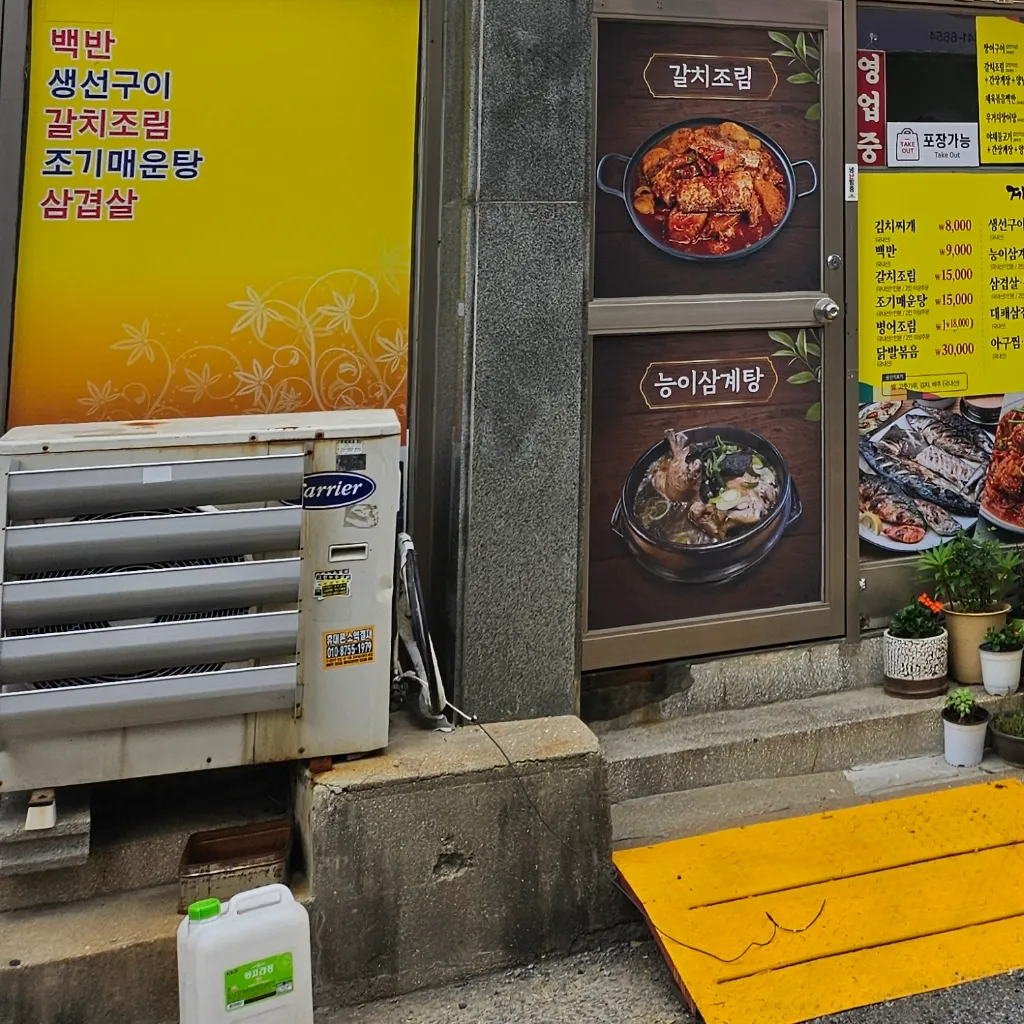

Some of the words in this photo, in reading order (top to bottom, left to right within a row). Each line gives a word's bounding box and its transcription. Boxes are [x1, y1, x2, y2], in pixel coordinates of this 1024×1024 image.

[51, 28, 116, 60] 백반
[47, 69, 172, 101] 생선구이
[669, 63, 753, 90] 갈치조림
[857, 53, 882, 163] 영업중
[45, 108, 171, 140] 갈치조림
[923, 133, 971, 149] 포장가능
[42, 149, 203, 179] 조기매운탕
[40, 188, 138, 221] 삼겹살
[875, 219, 916, 234] 김치찌개
[875, 244, 897, 259] 백반
[875, 269, 916, 283] 갈치조림
[875, 294, 928, 309] 조기매운탕
[876, 319, 916, 334] 병어조림
[876, 345, 919, 360] 닭발볶음
[653, 368, 765, 399] 능이삼계탕
[303, 481, 363, 498] arrier
